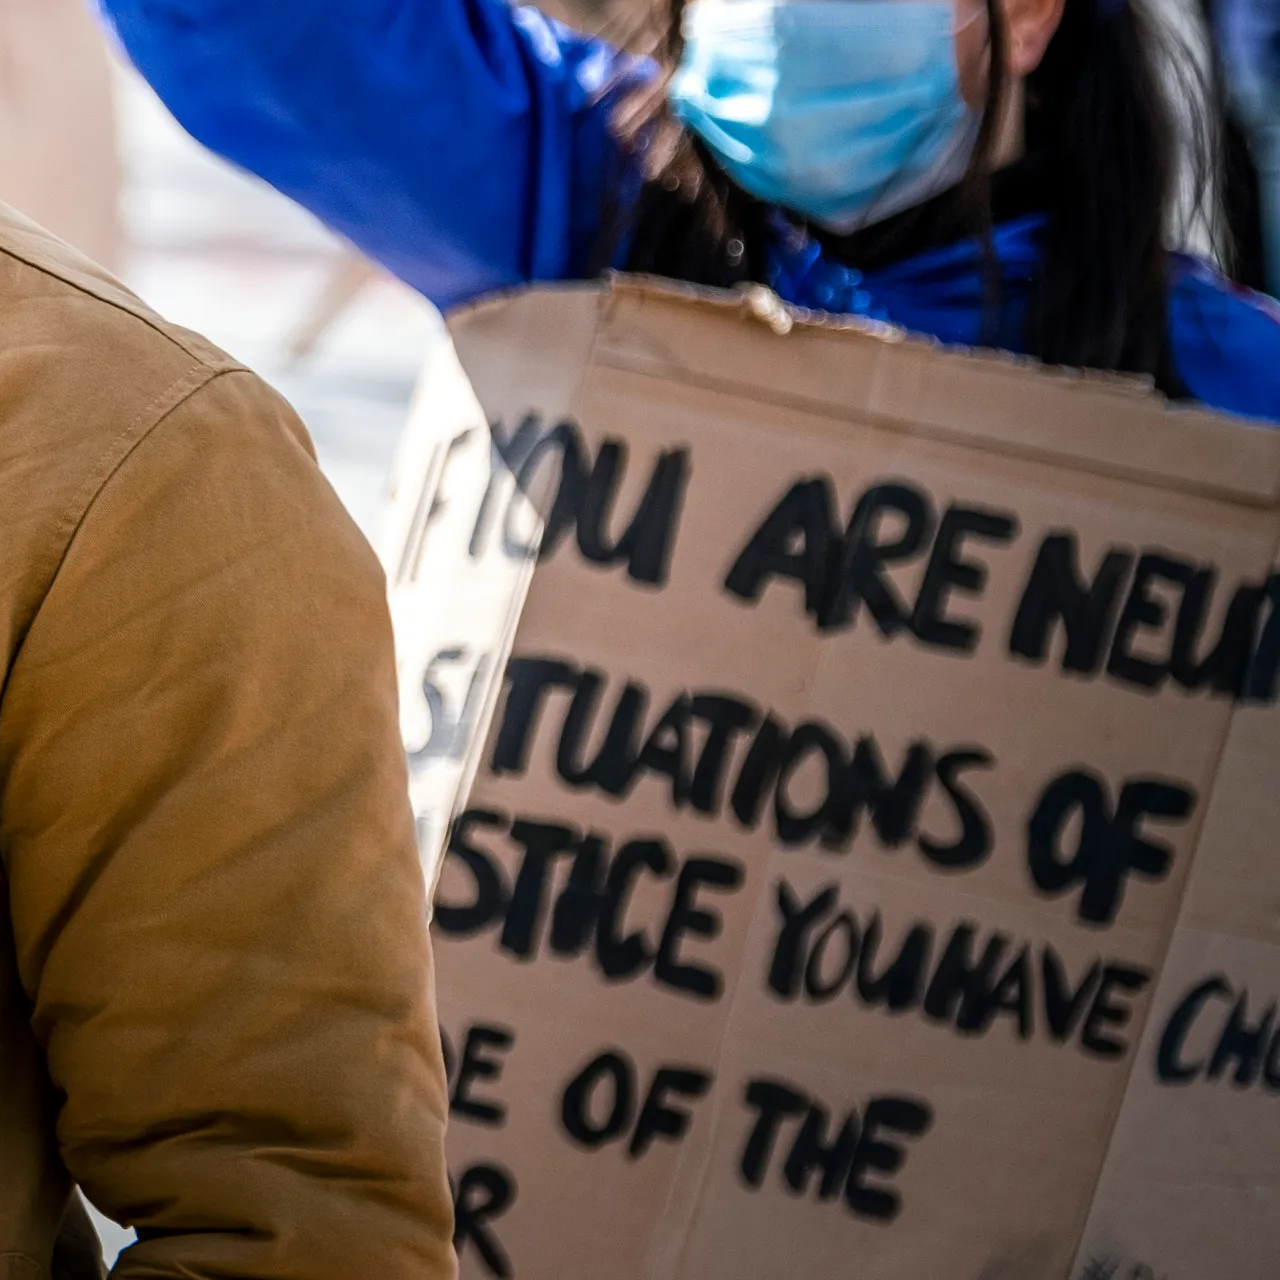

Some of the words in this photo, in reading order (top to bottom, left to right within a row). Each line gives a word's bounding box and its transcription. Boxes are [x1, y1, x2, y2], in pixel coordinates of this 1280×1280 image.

[465, 410, 692, 586] YOU
[722, 475, 1020, 654] ARE
[422, 808, 745, 1004] STICE
[1026, 765, 1196, 932] OF
[558, 1048, 714, 1164] OF
[740, 1074, 936, 1226] THE
